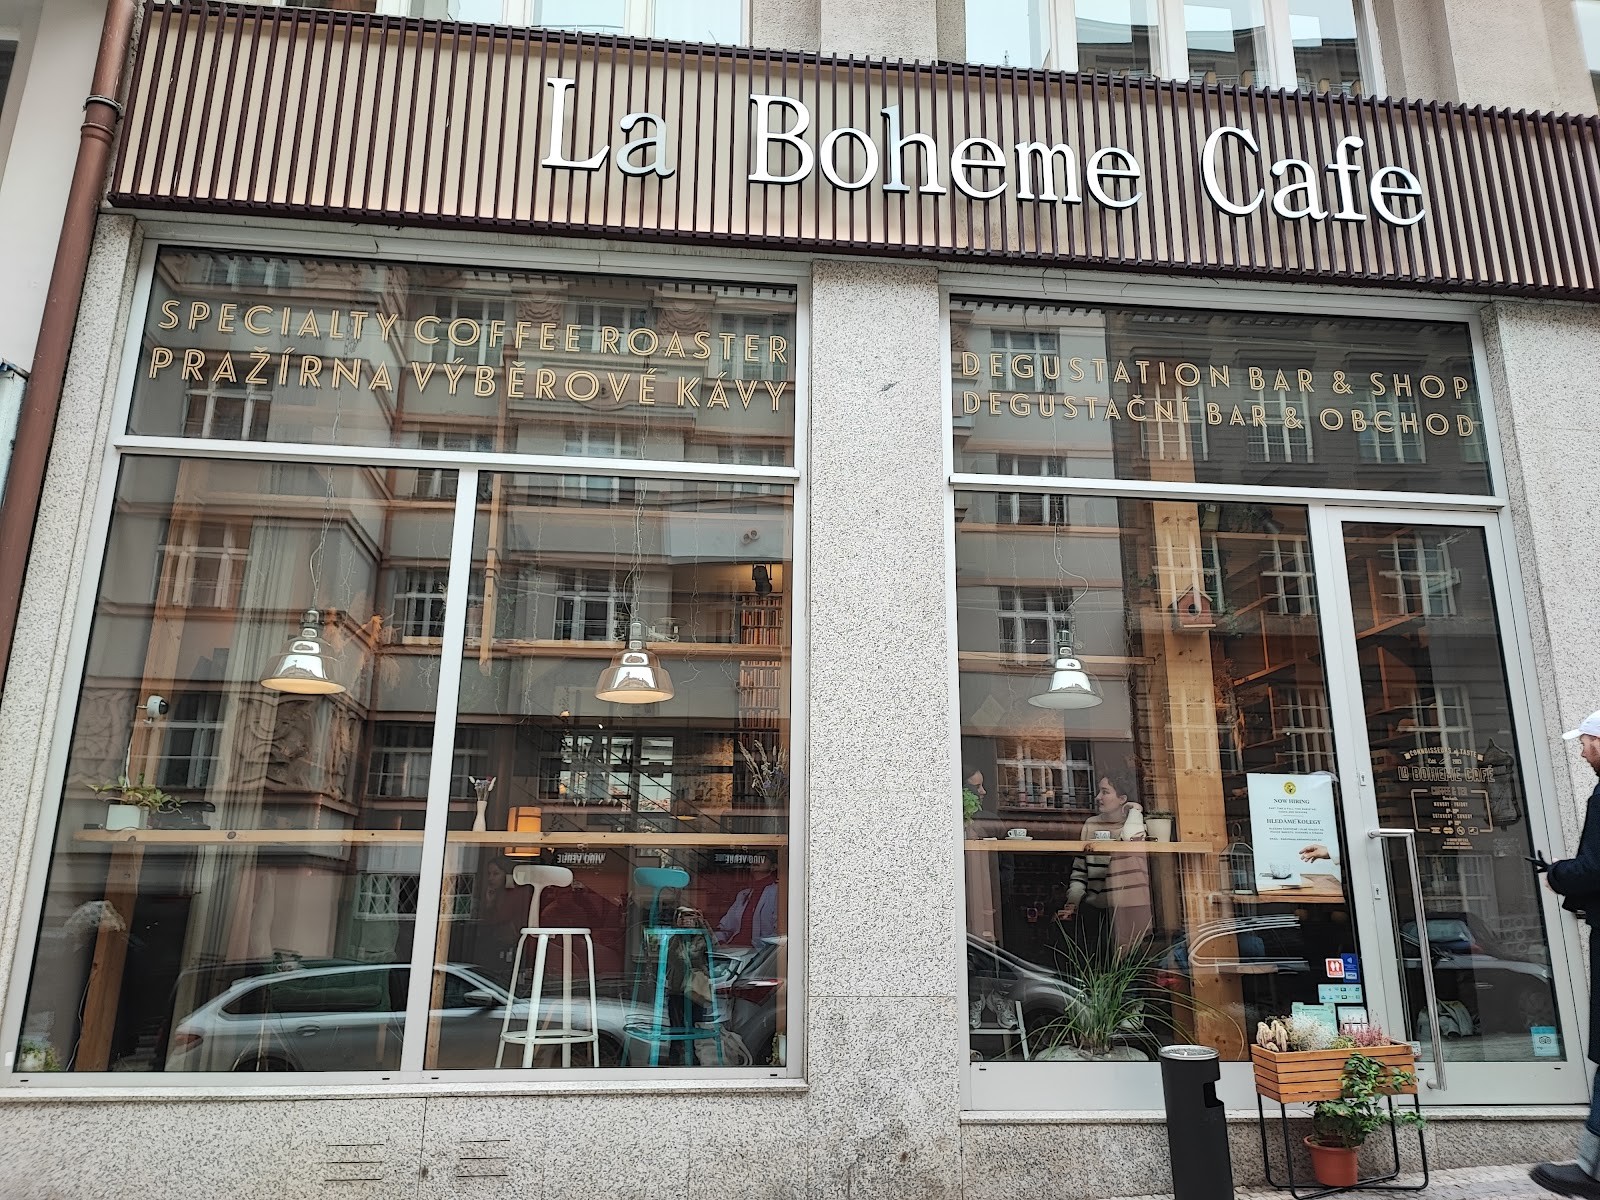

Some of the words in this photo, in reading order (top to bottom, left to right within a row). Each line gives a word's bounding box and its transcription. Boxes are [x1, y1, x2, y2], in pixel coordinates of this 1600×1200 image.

[541, 76, 675, 178] La
[748, 93, 1143, 210] Boheme
[1201, 125, 1427, 226] Cafe
[157, 299, 399, 342] SPECIALTY
[413, 315, 582, 353] COFFEE
[600, 325, 788, 364] ROASTER
[148, 346, 394, 391] PRAŽÍRNA
[411, 357, 658, 405] VÝBĚROVÉ
[676, 371, 788, 412] KÁVY
[961, 351, 1230, 389] DEGUSTATION
[1248, 366, 1315, 393] BAR
[1332, 370, 1354, 395] &
[1369, 372, 1469, 400] SHOP
[962, 390, 1190, 424] DEGUSTAČNÍ
[1206, 402, 1267, 428] BAR
[1283, 406, 1304, 429] &
[1319, 408, 1474, 437] OBCHOD
[1460, 748, 1477, 758] TASTE
